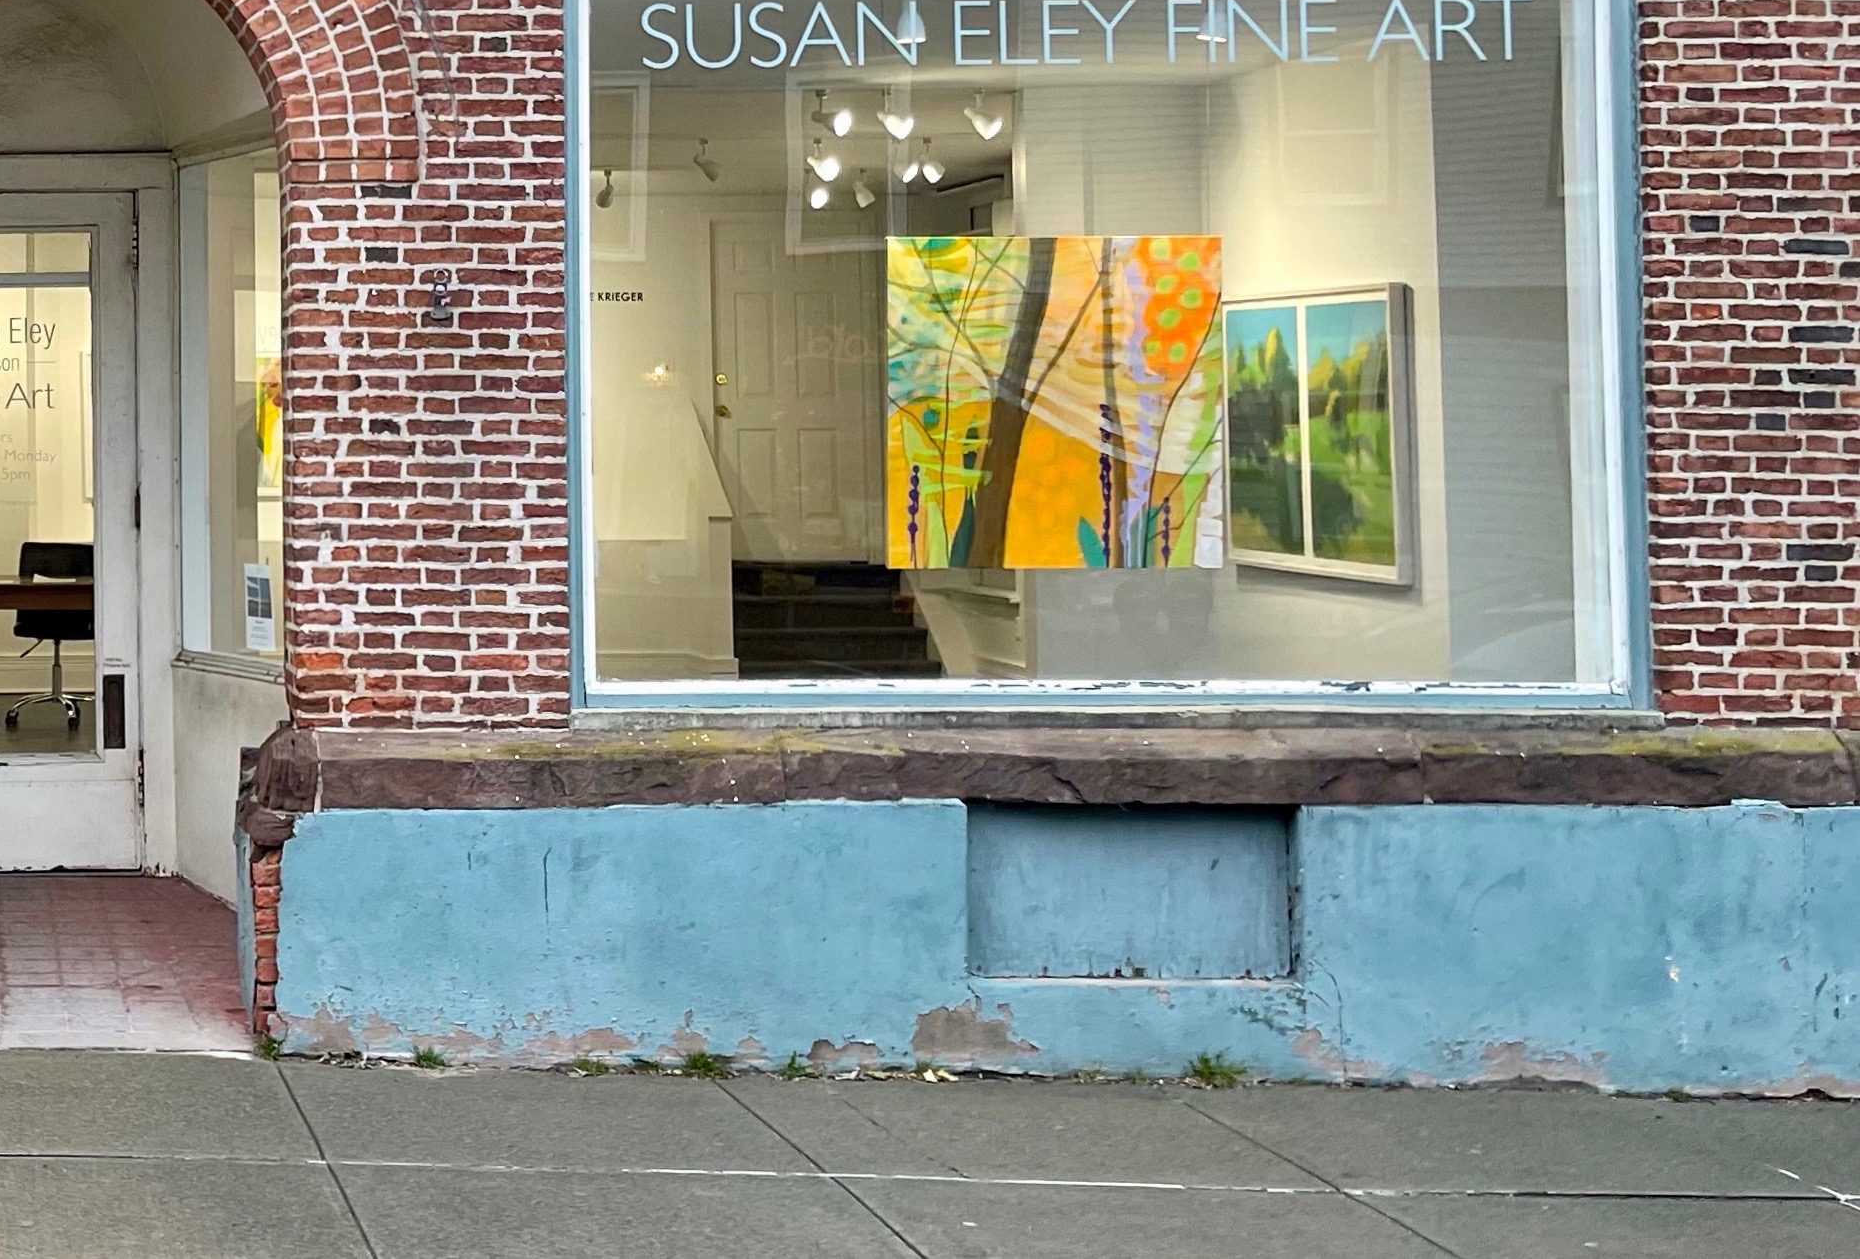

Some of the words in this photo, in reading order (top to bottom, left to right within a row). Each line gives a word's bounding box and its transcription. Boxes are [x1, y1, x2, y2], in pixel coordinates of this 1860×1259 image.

[641, 1, 918, 69] SUSAN
[597, 292, 643, 301] KRIEGER
[9, 316, 56, 349] Eley
[4, 382, 55, 410] Art
[4, 447, 57, 463] Monday
[1, 468, 31, 483] 5pm
